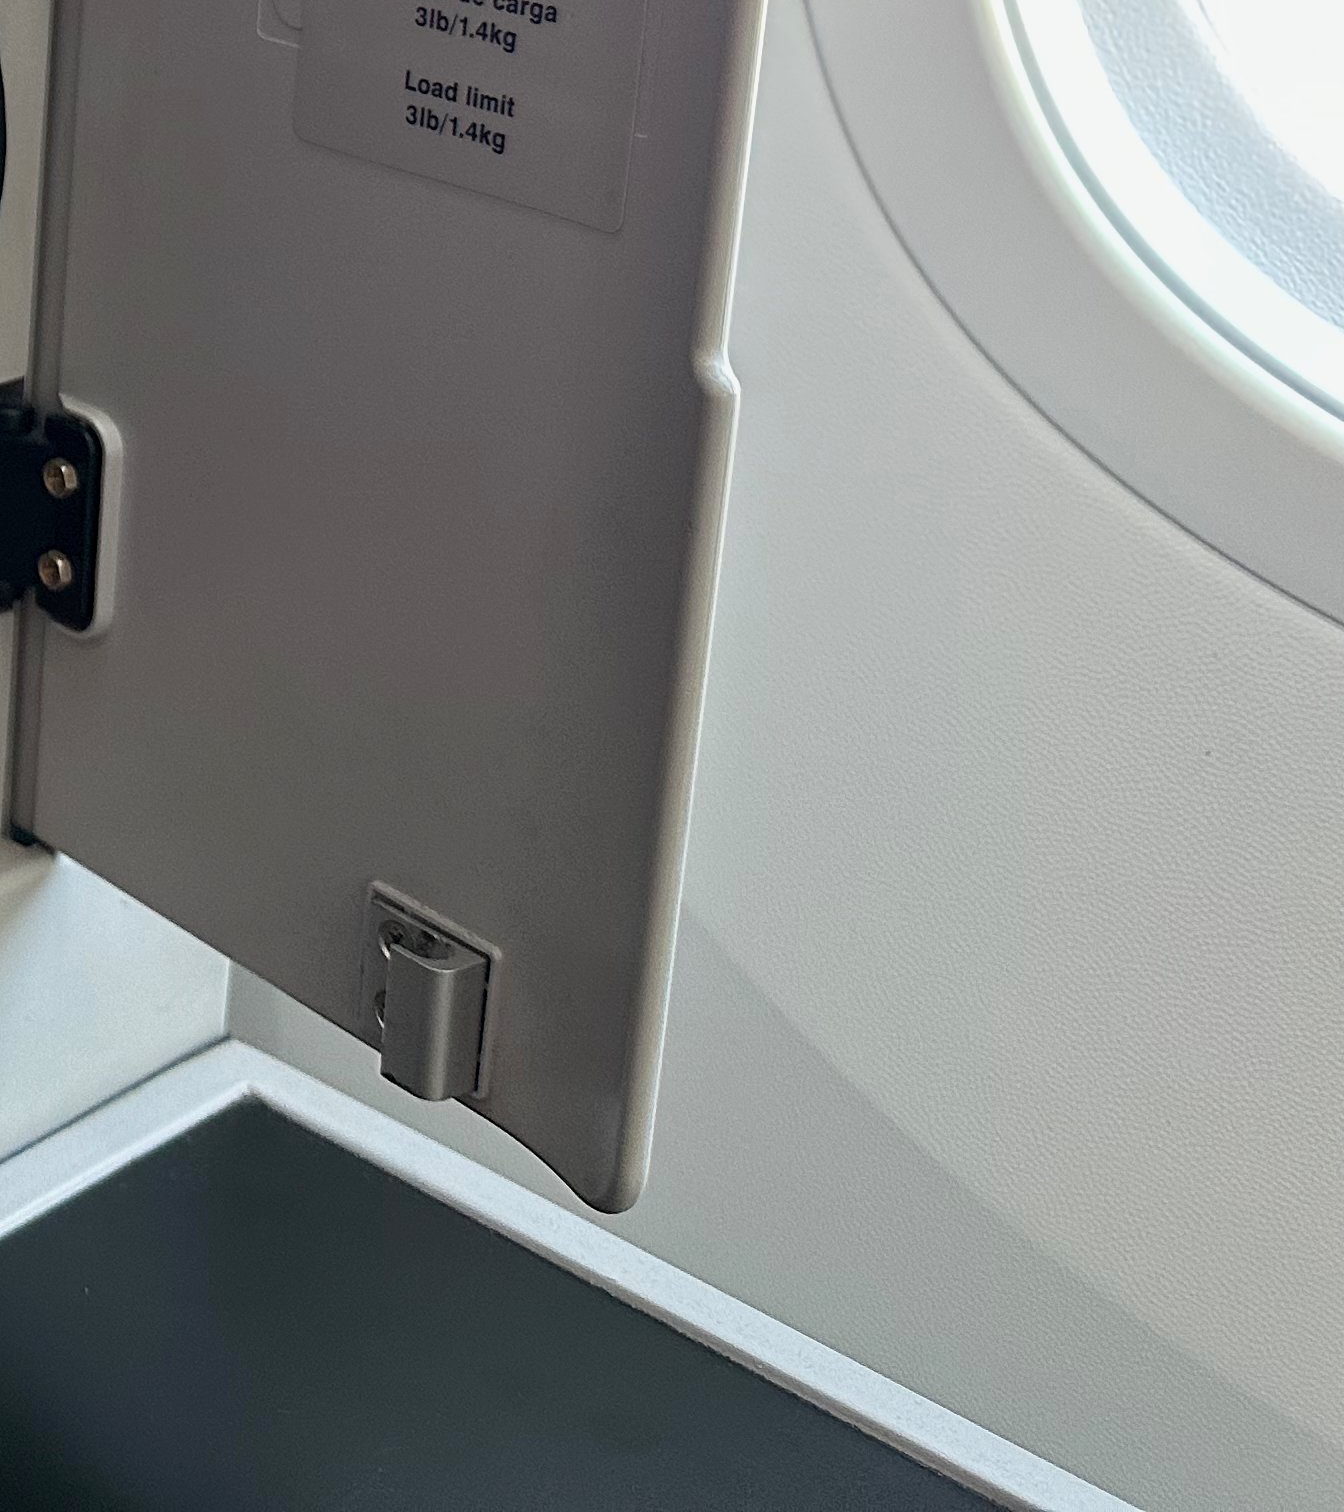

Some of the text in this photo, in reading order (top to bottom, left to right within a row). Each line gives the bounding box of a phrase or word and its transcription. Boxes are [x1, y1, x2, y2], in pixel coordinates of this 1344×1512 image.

[414, 6, 518, 54] 3lb/1.4kg
[404, 69, 516, 118] Load limit
[405, 104, 507, 155] 3lb/1.4kg
